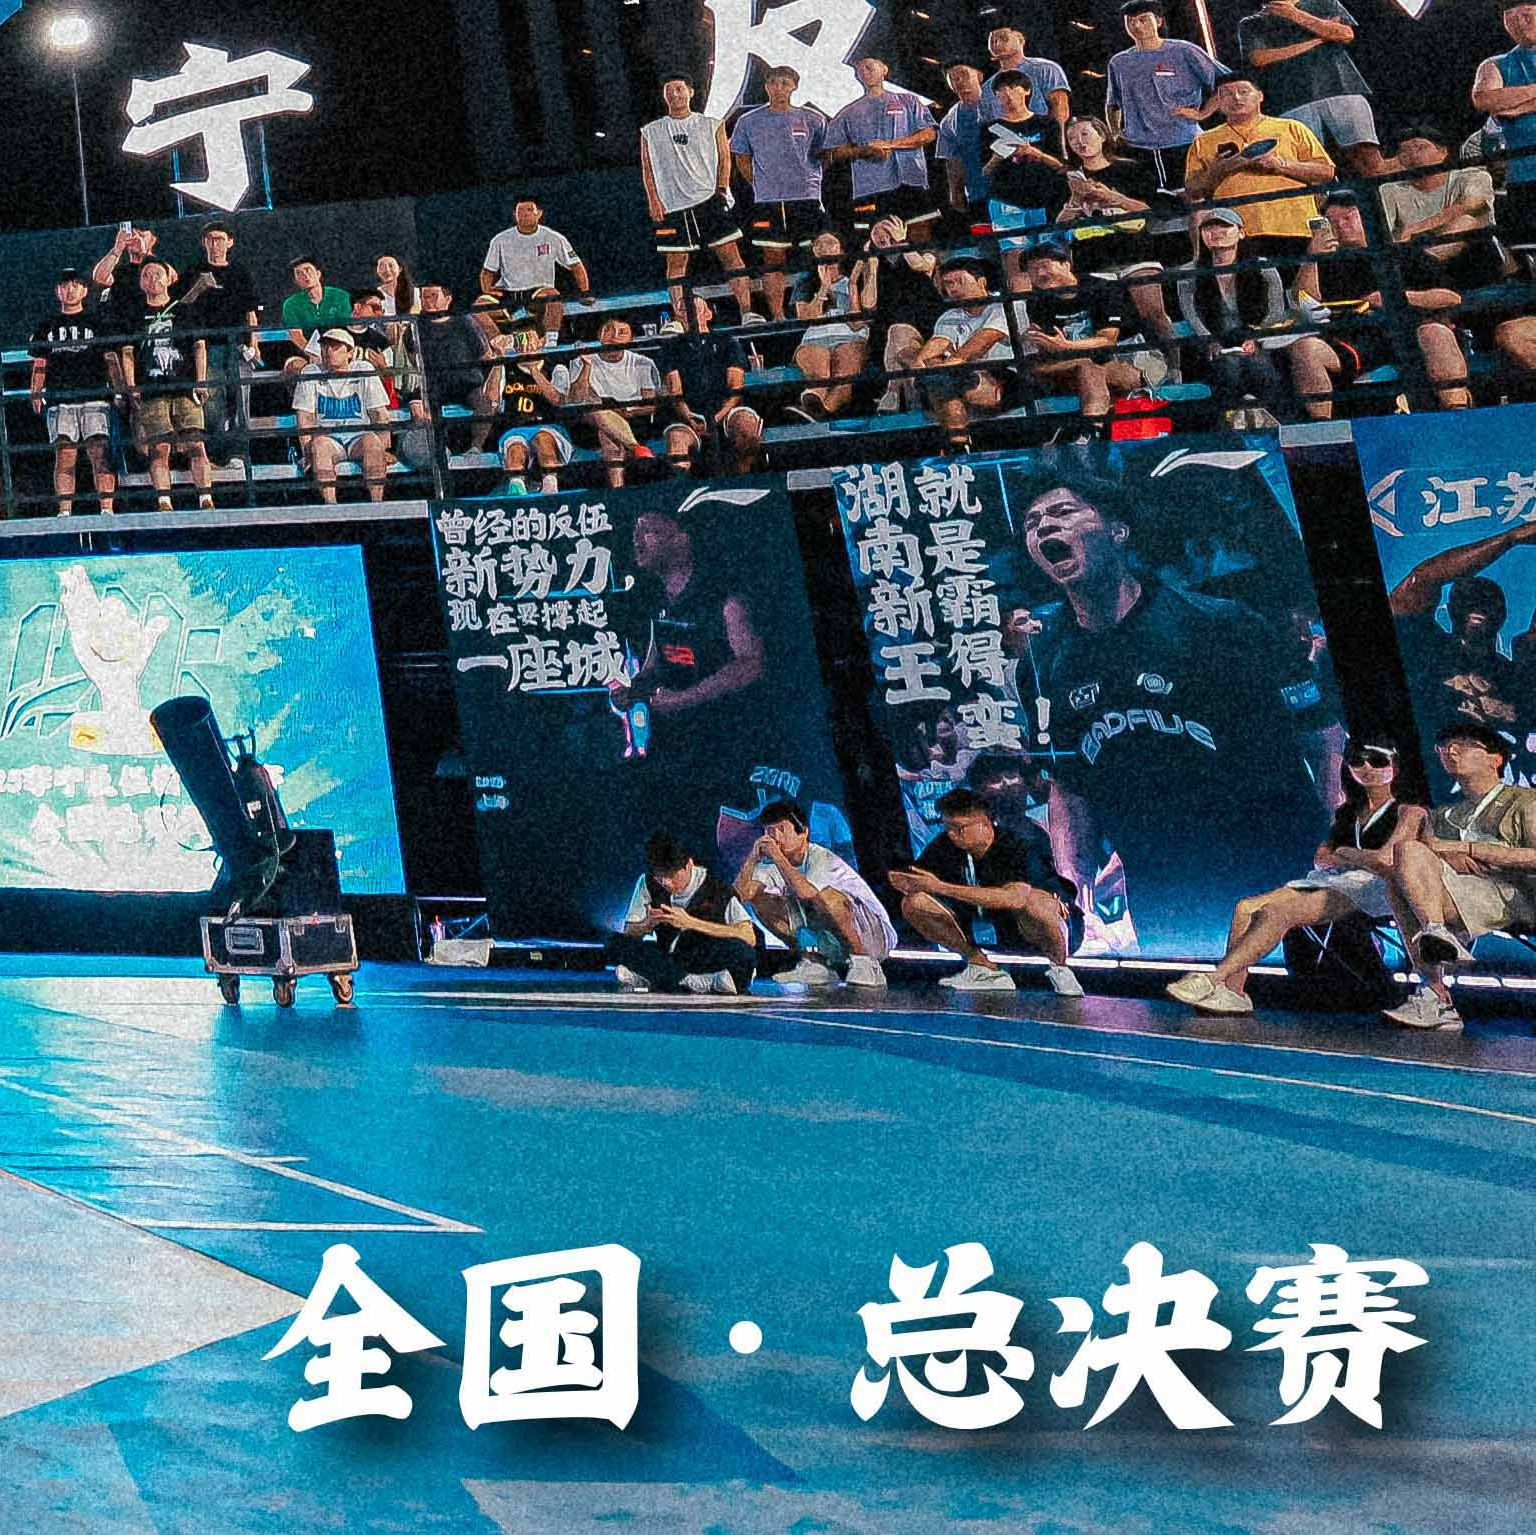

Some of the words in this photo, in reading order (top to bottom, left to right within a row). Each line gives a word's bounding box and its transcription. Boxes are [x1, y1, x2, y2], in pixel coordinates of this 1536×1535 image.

[121, 41, 313, 212] 宁
[518, 397, 534, 413] 10
[436, 503, 613, 546] 曾经的反伍
[842, 461, 951, 704] 湖南新王
[456, 631, 632, 692] 一座城
